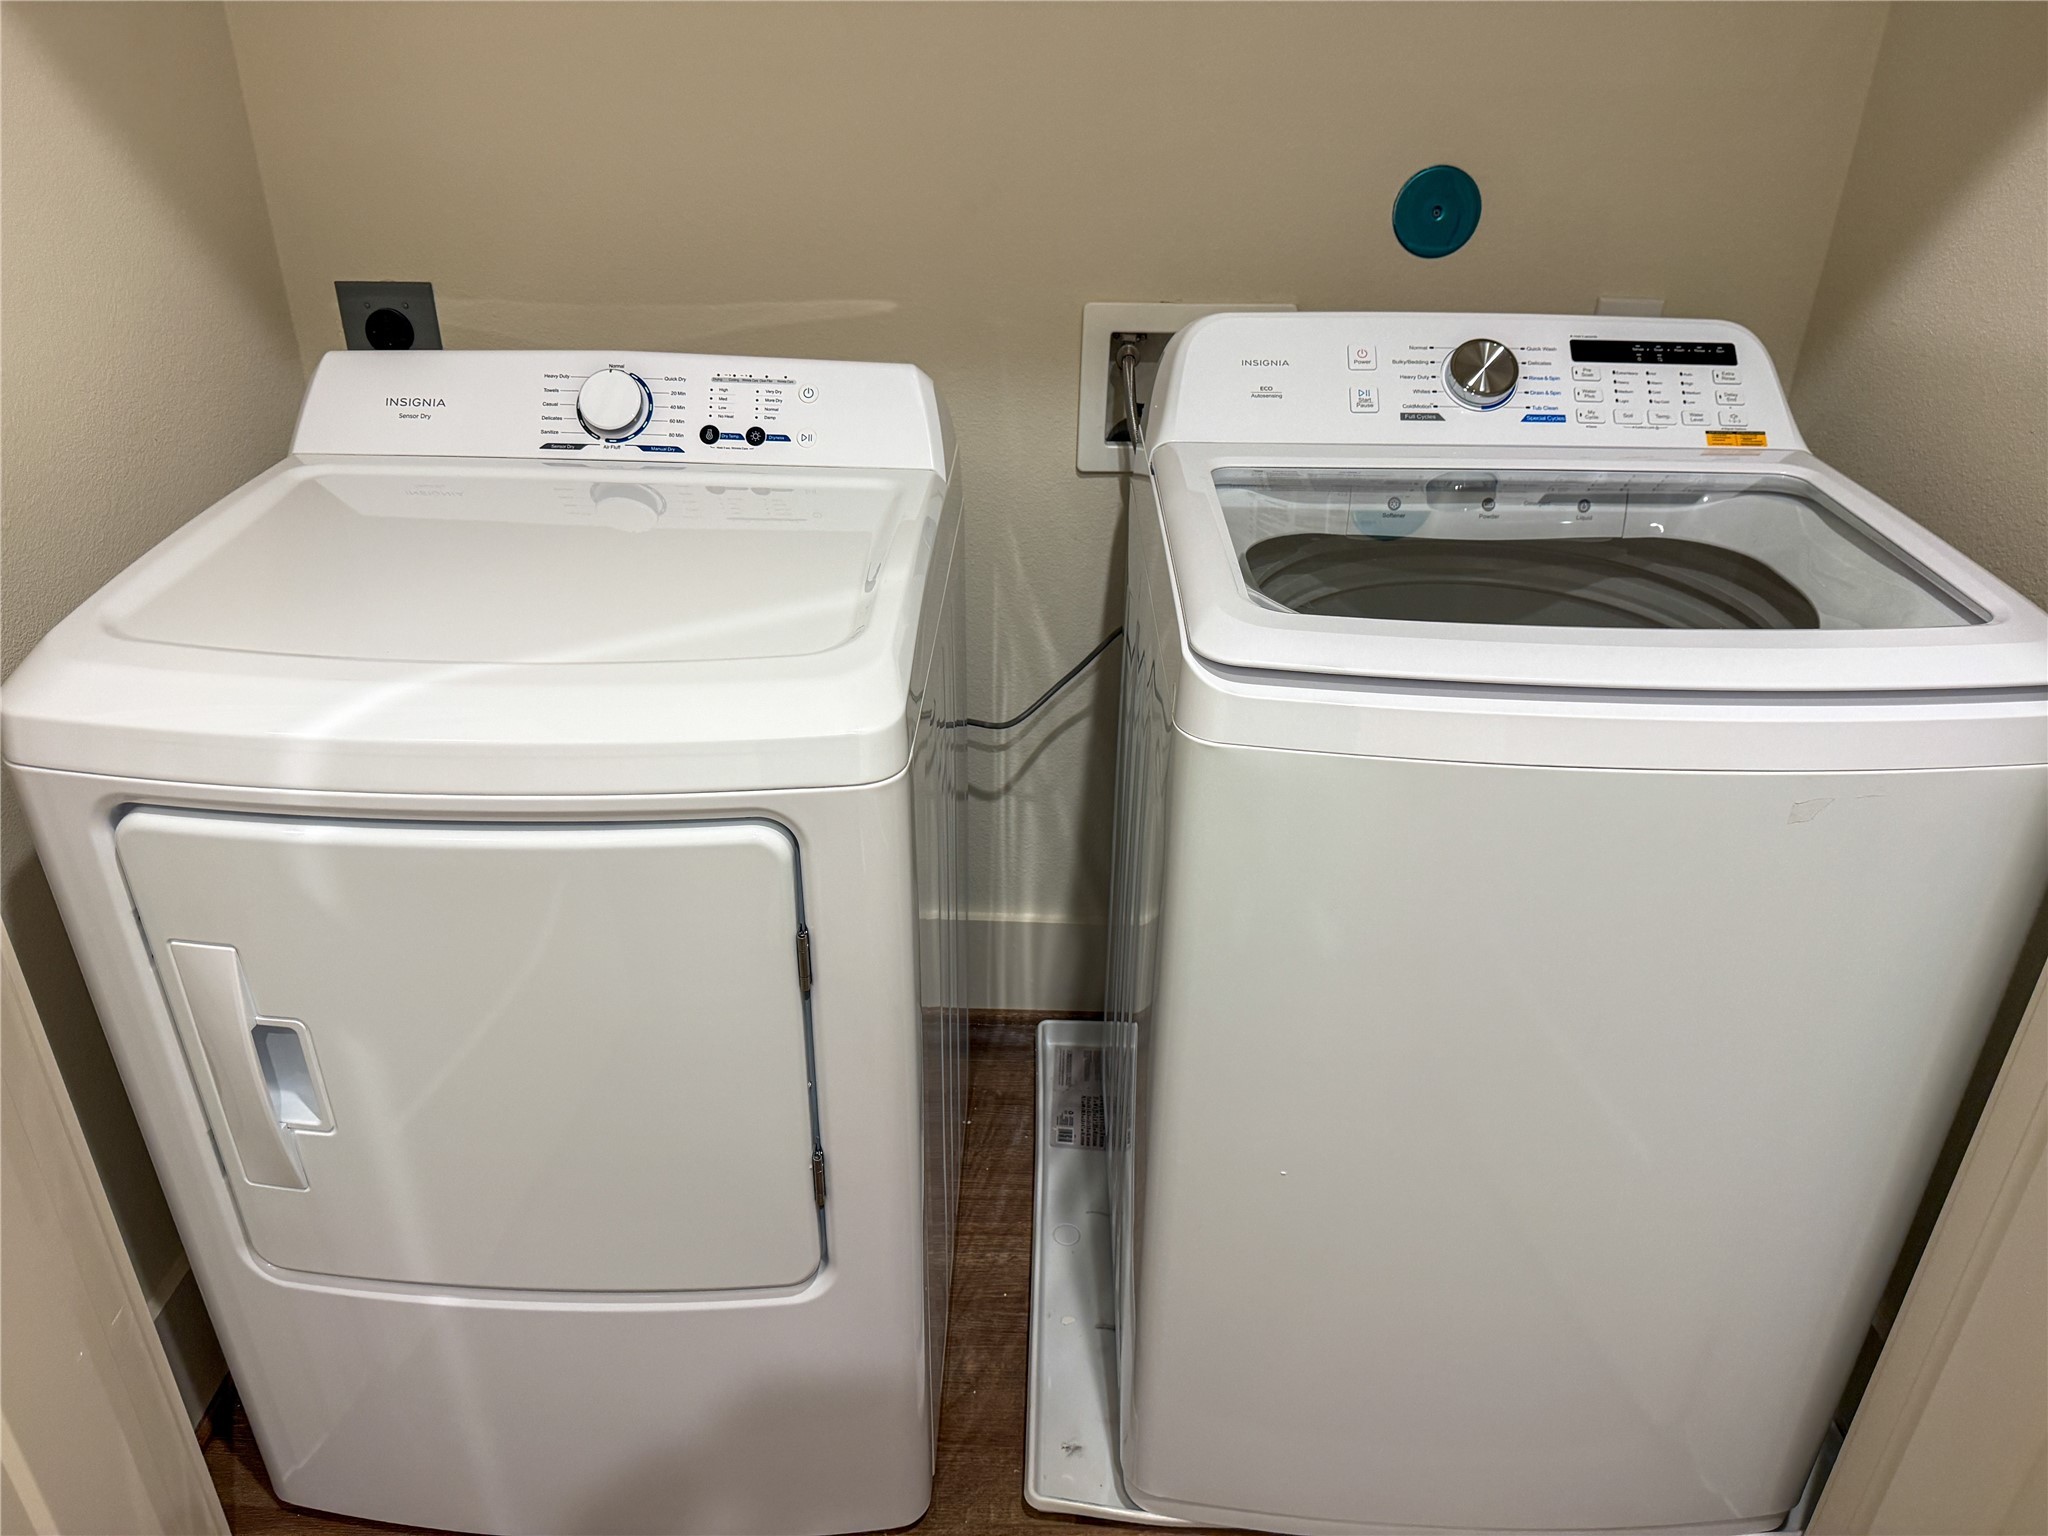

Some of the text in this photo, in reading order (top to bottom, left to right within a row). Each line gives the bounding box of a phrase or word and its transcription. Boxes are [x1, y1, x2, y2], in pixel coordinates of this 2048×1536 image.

[1241, 359, 1290, 367] INSIGNIA
[385, 397, 447, 408] INSIGNIA
[1416, 413, 1436, 421] Cycles
[1546, 415, 1565, 423] Cycles
